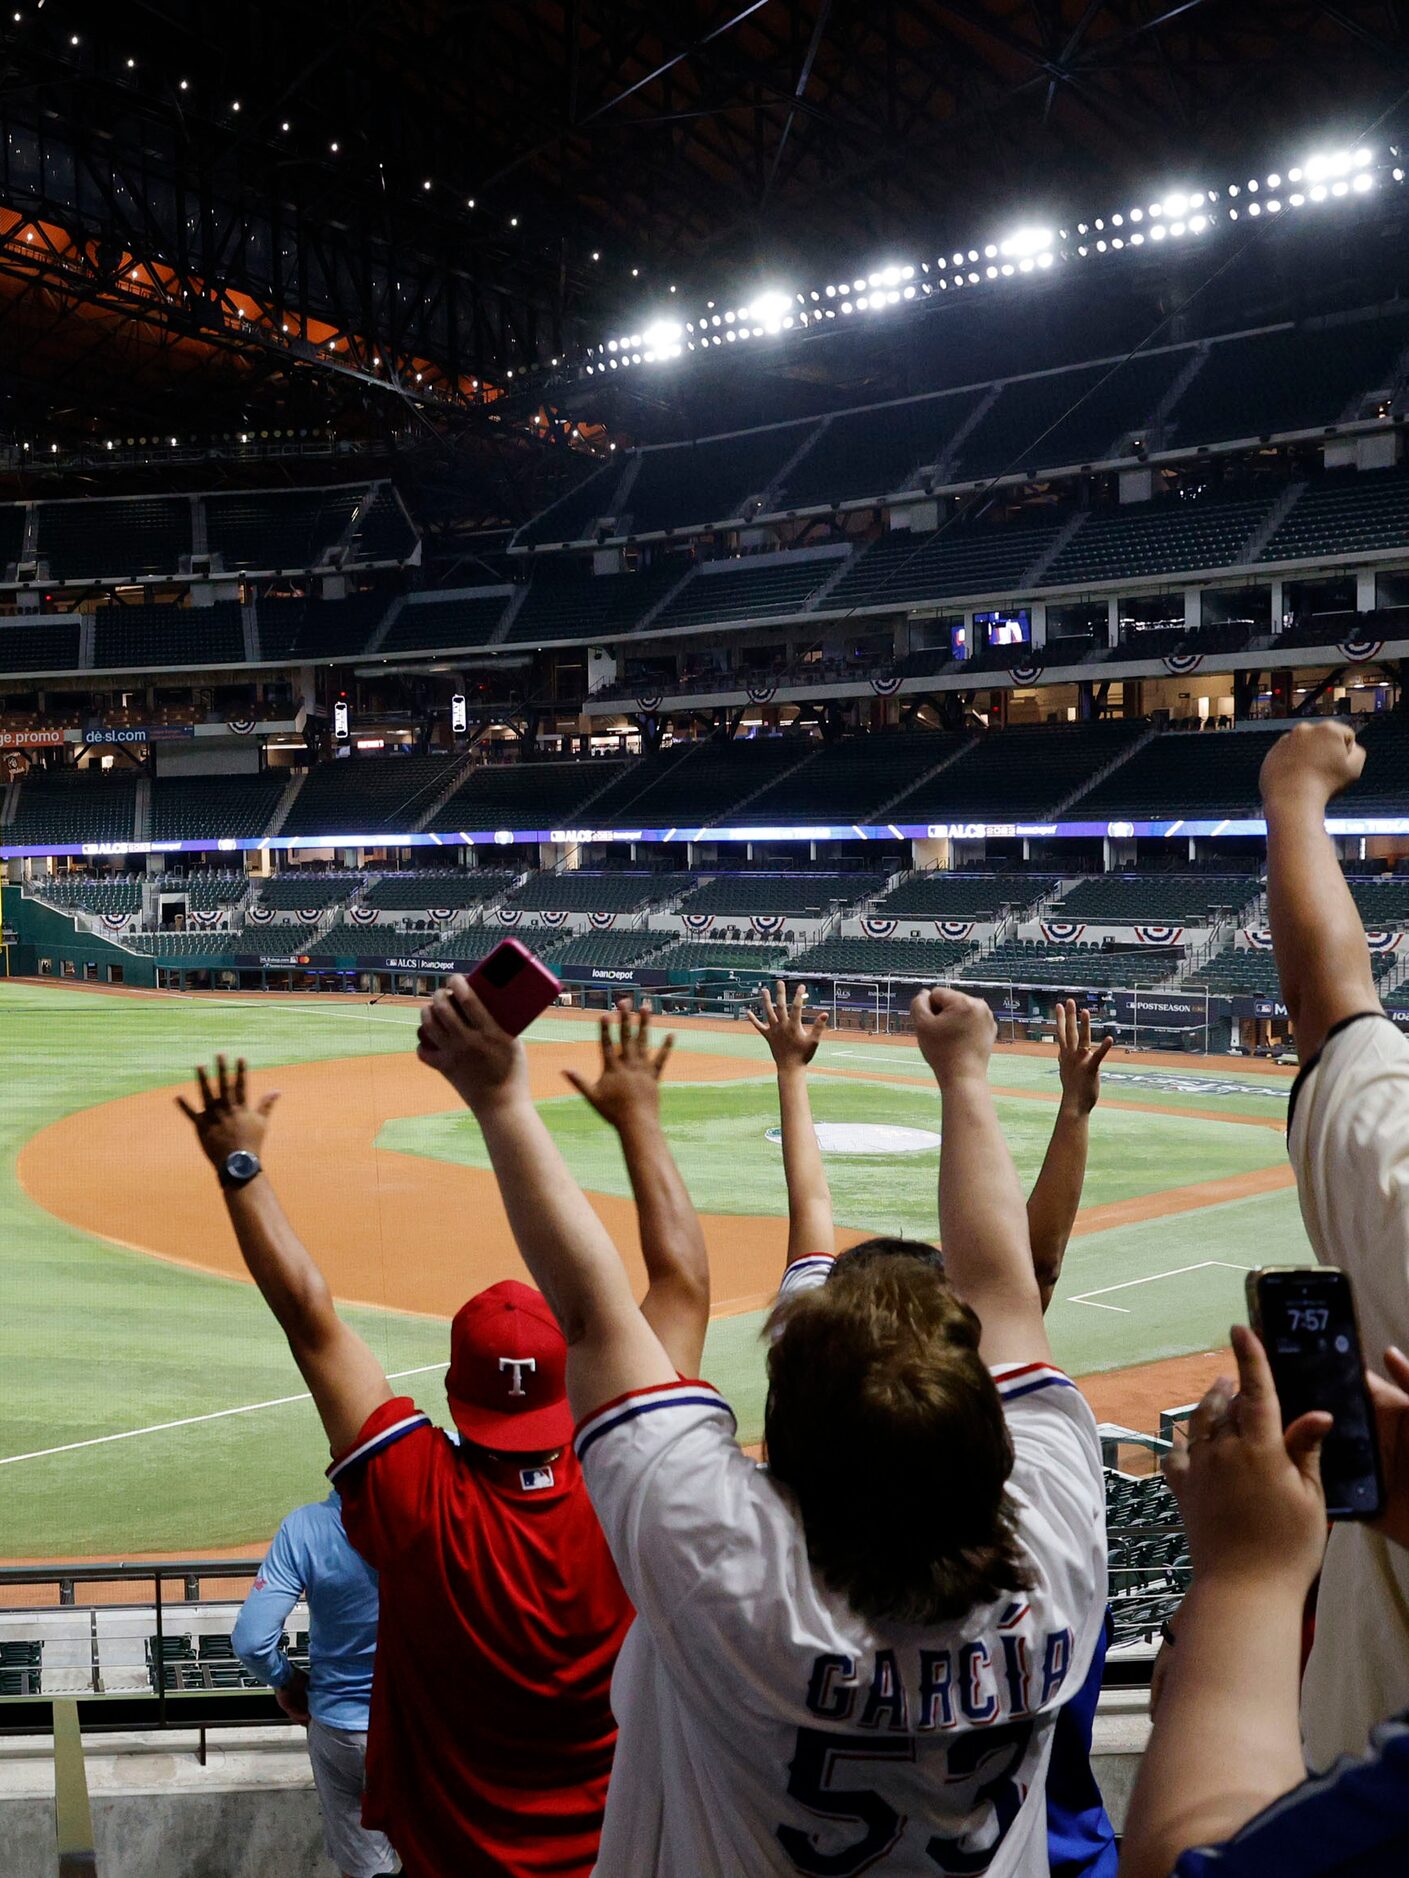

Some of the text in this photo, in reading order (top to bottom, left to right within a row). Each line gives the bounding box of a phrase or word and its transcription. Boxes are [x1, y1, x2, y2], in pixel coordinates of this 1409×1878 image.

[397, 958, 417, 968] ALCS
[591, 968, 633, 981] loanDepot
[1137, 1002, 1191, 1013] POSTSEASON
[1287, 1308, 1329, 1331] 7:57
[498, 1357, 536, 1396] T
[775, 1725, 1034, 1877] 53
